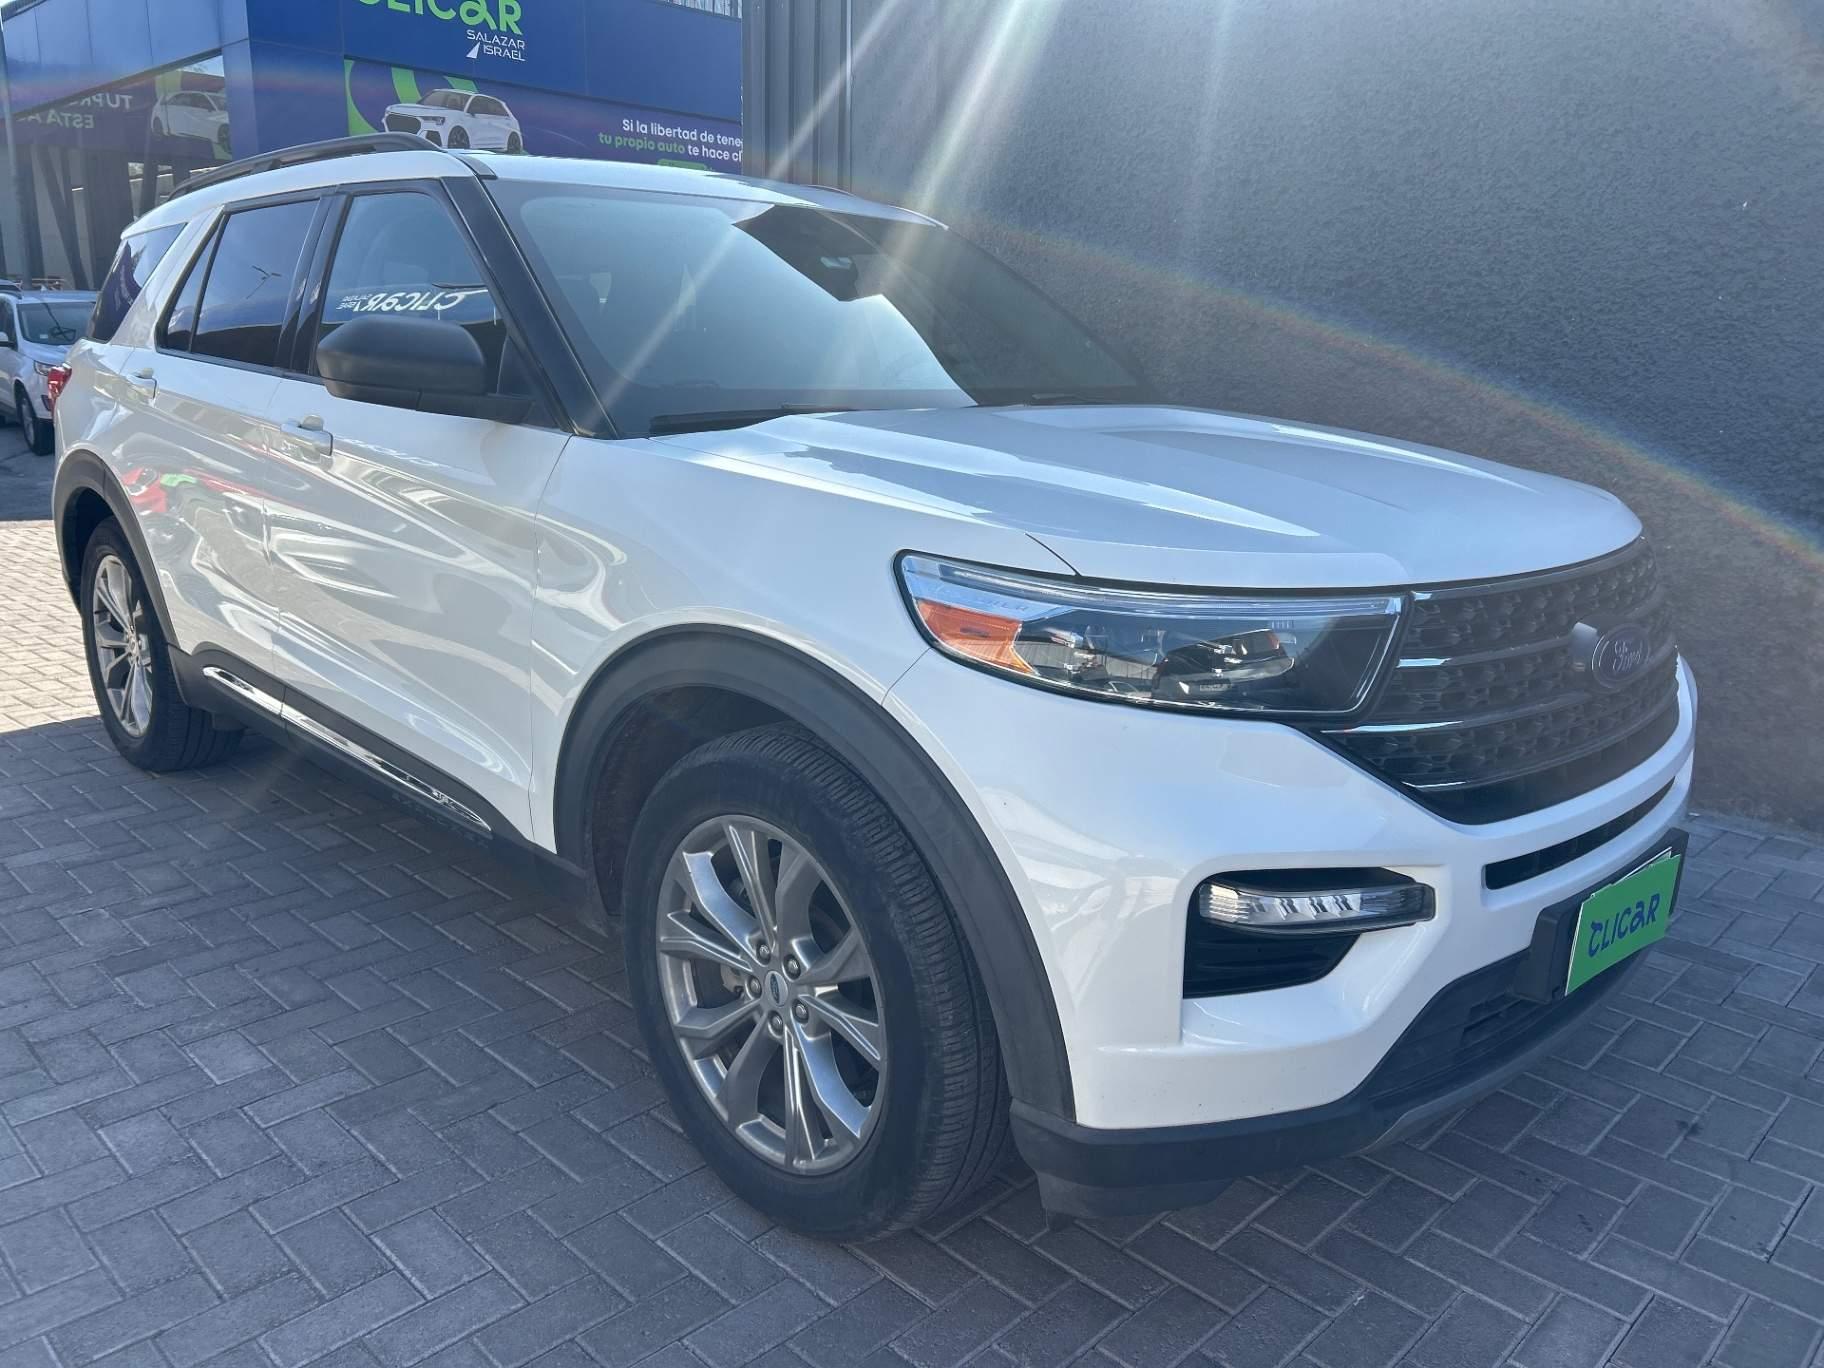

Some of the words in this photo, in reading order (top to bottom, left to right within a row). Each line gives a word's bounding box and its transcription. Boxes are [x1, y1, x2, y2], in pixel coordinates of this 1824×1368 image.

[466, 29, 526, 50] SALAZAR
[483, 45, 526, 61] ISRAEL
[622, 119, 634, 132] Si
[636, 120, 648, 134] la
[650, 122, 698, 141] libertad
[700, 130, 715, 143] de
[598, 132, 612, 145] tu
[614, 135, 656, 151] propio
[657, 141, 685, 154] auto
[687, 144, 700, 156] te
[702, 145, 730, 160] hace
